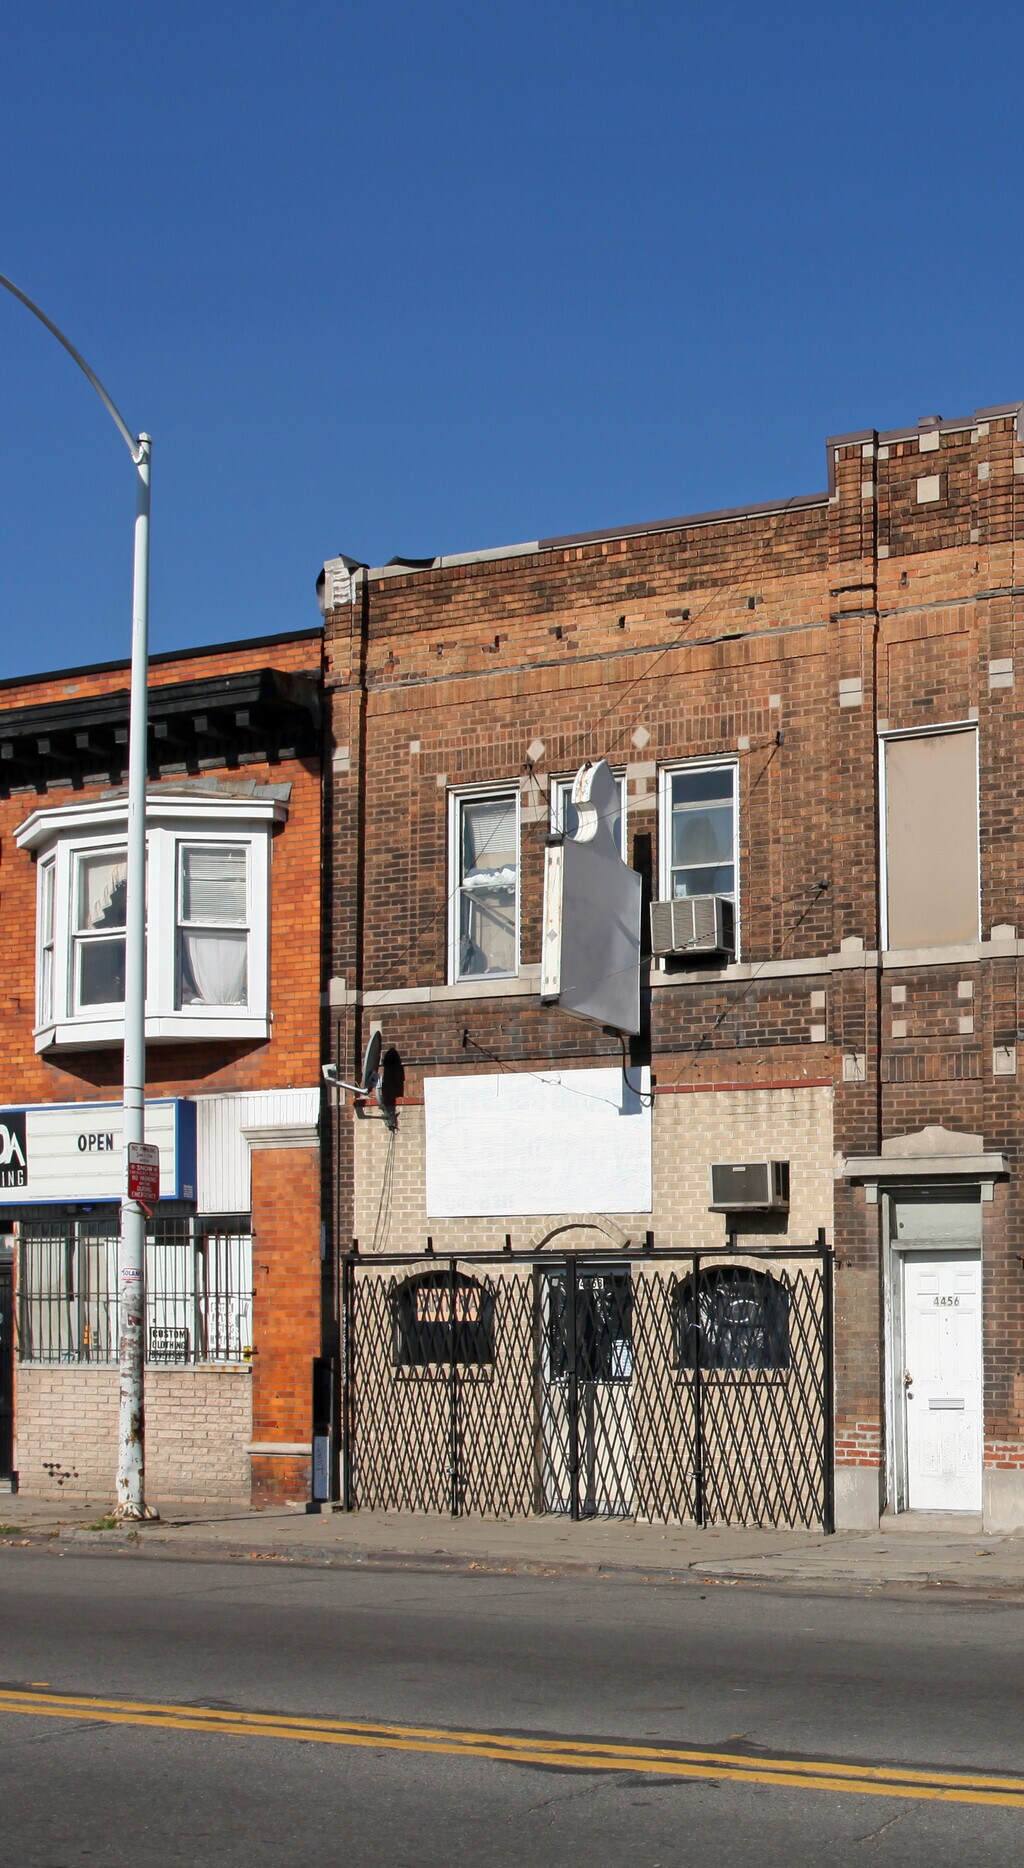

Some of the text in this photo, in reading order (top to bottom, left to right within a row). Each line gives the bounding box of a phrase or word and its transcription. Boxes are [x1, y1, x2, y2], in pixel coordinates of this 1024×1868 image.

[77, 1133, 114, 1152] OPEN
[933, 1296, 960, 1307] 4456
[152, 1329, 186, 1339] CUSTOM
